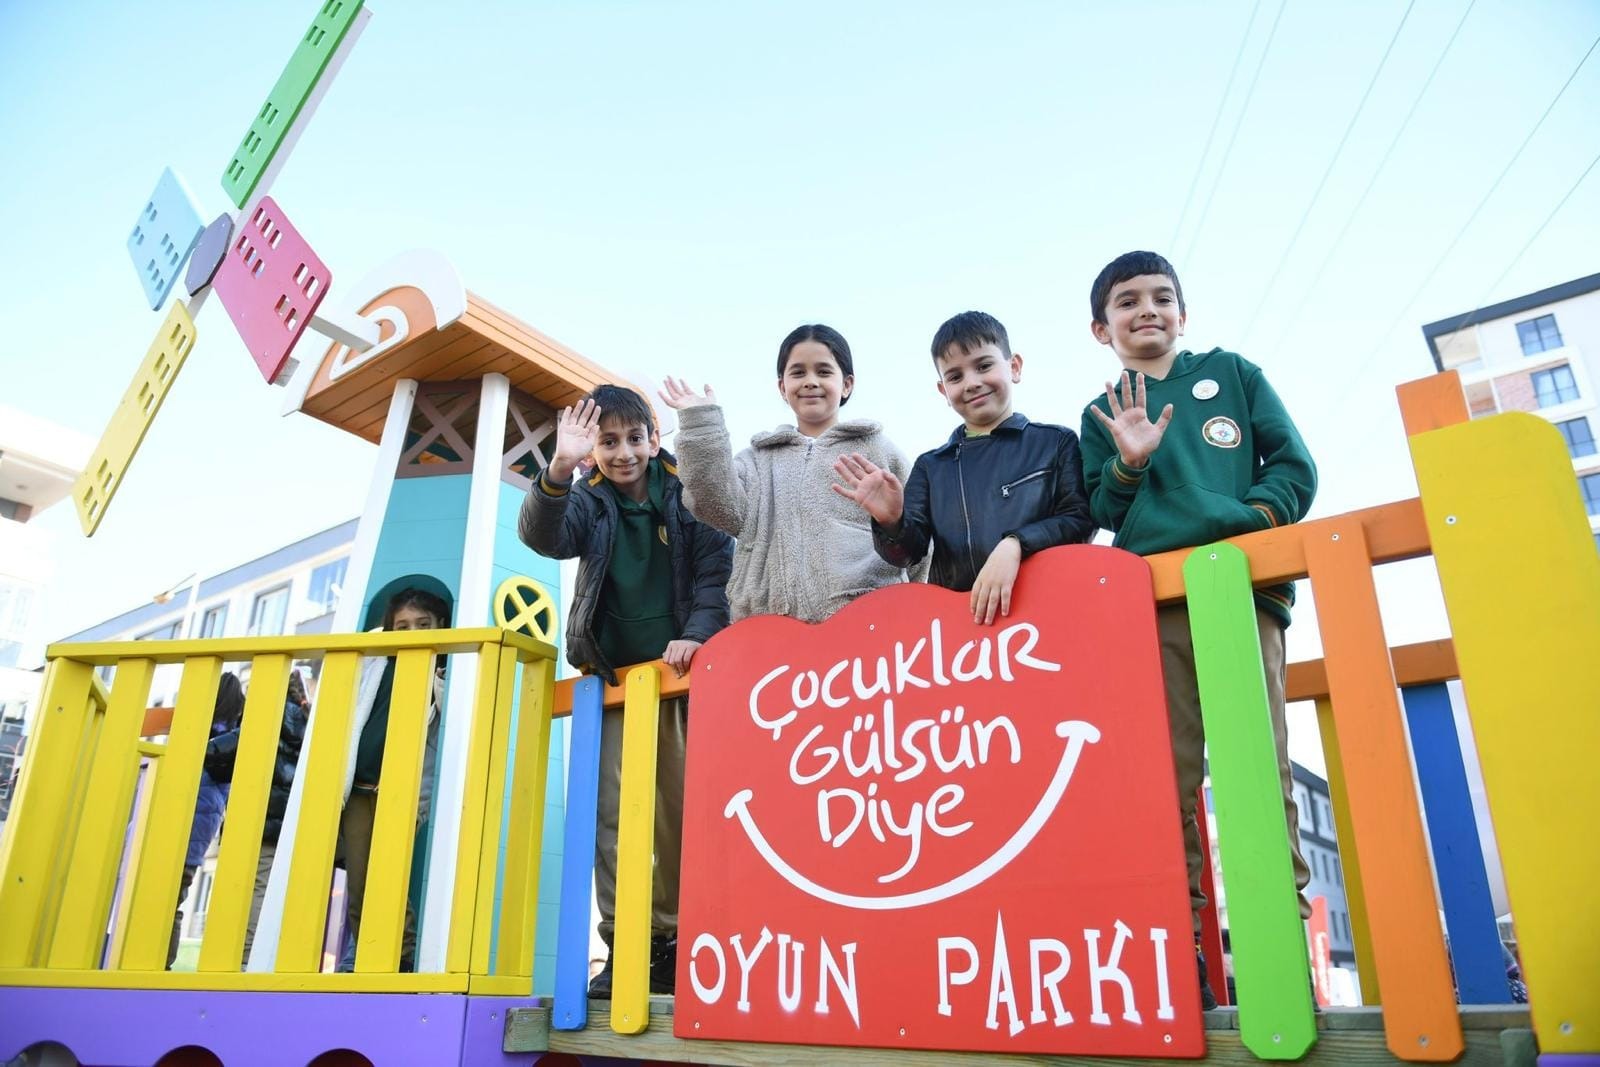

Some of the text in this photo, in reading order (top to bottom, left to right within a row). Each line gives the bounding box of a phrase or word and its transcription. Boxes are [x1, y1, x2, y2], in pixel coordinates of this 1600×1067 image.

[788, 697, 1022, 786] Gülsün
[816, 781, 974, 884] Diye
[688, 925, 861, 1029] OYUN
[936, 910, 1176, 1038] PARKI
